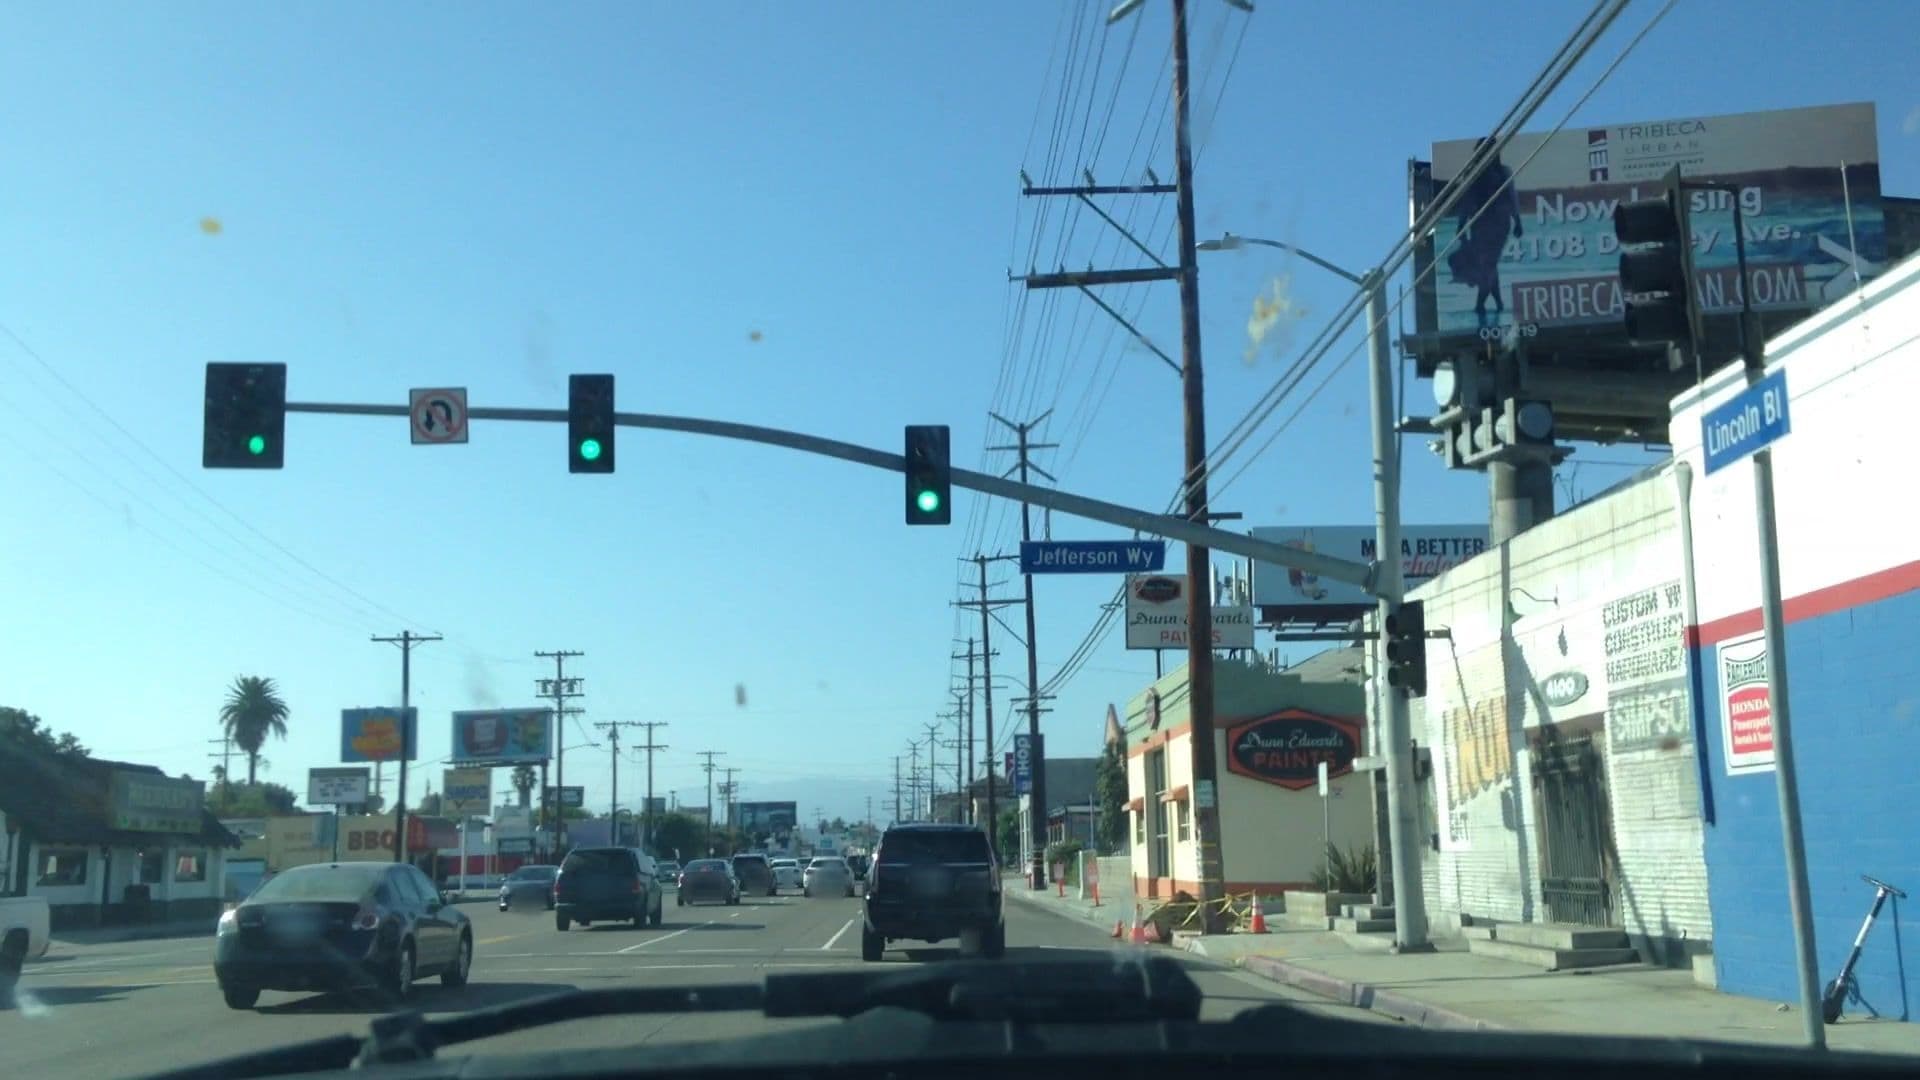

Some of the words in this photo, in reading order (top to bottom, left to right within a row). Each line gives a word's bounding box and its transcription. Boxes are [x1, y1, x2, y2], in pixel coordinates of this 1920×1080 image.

[1618, 120, 1706, 141] TRIBECA
[1624, 140, 1700, 154] URBAN
[1535, 193, 1619, 225] Now
[1501, 232, 1586, 262] 4108
[1518, 266, 1800, 322] TRIBECAAN.COM
[1707, 403, 1761, 457] Lincoln
[1763, 386, 1782, 427] Bl
[1032, 546, 1118, 566] Jefferson
[1127, 546, 1153, 568] Wy
[1401, 538, 1412, 556] A
[1416, 537, 1485, 556] BETTER
[1160, 630, 1222, 643] PAIS
[1732, 697, 1770, 715] HONDA
[1017, 737, 1031, 776] IHOP
[1253, 752, 1337, 769] PAINTS
